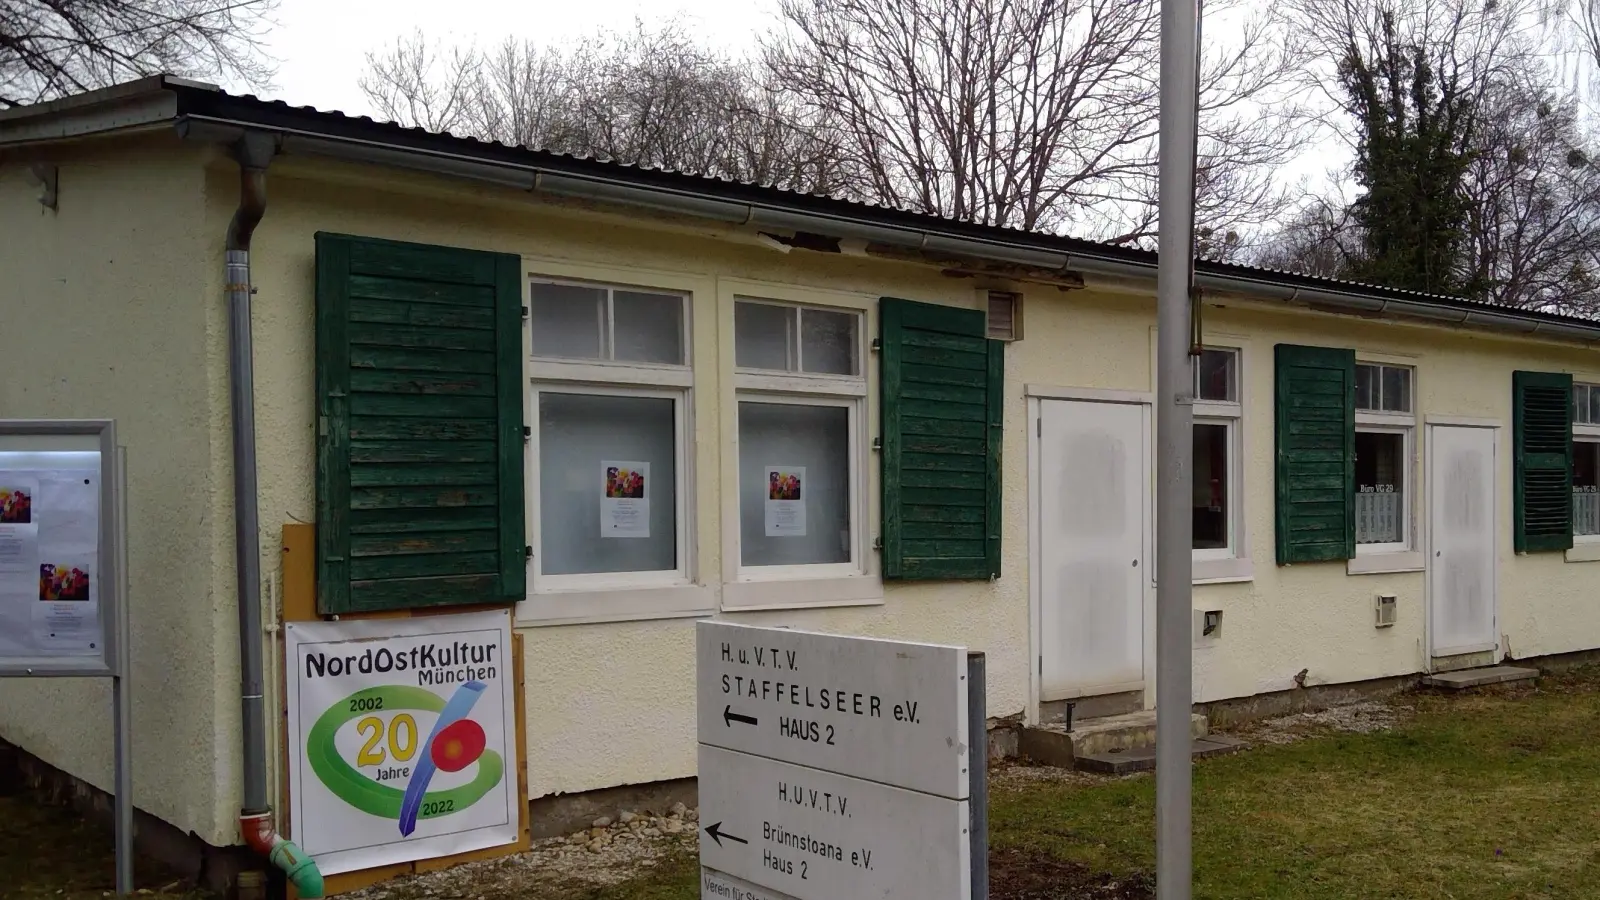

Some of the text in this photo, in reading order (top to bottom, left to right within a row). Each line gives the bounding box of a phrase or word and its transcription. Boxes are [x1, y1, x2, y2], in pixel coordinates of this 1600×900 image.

[306, 641, 497, 678] NordOstKultur
[418, 665, 496, 686] München
[350, 697, 383, 712] 2002
[721, 674, 920, 724] STAFFELSEER e.V.
[356, 713, 418, 767] 20
[779, 716, 835, 746] HAUS 2
[376, 766, 410, 781] Jahre
[422, 799, 454, 816] 2022
[763, 821, 874, 871] Brünnstoana e.V.
[763, 848, 808, 880] Haus 2
[704, 876, 731, 899] Verein
